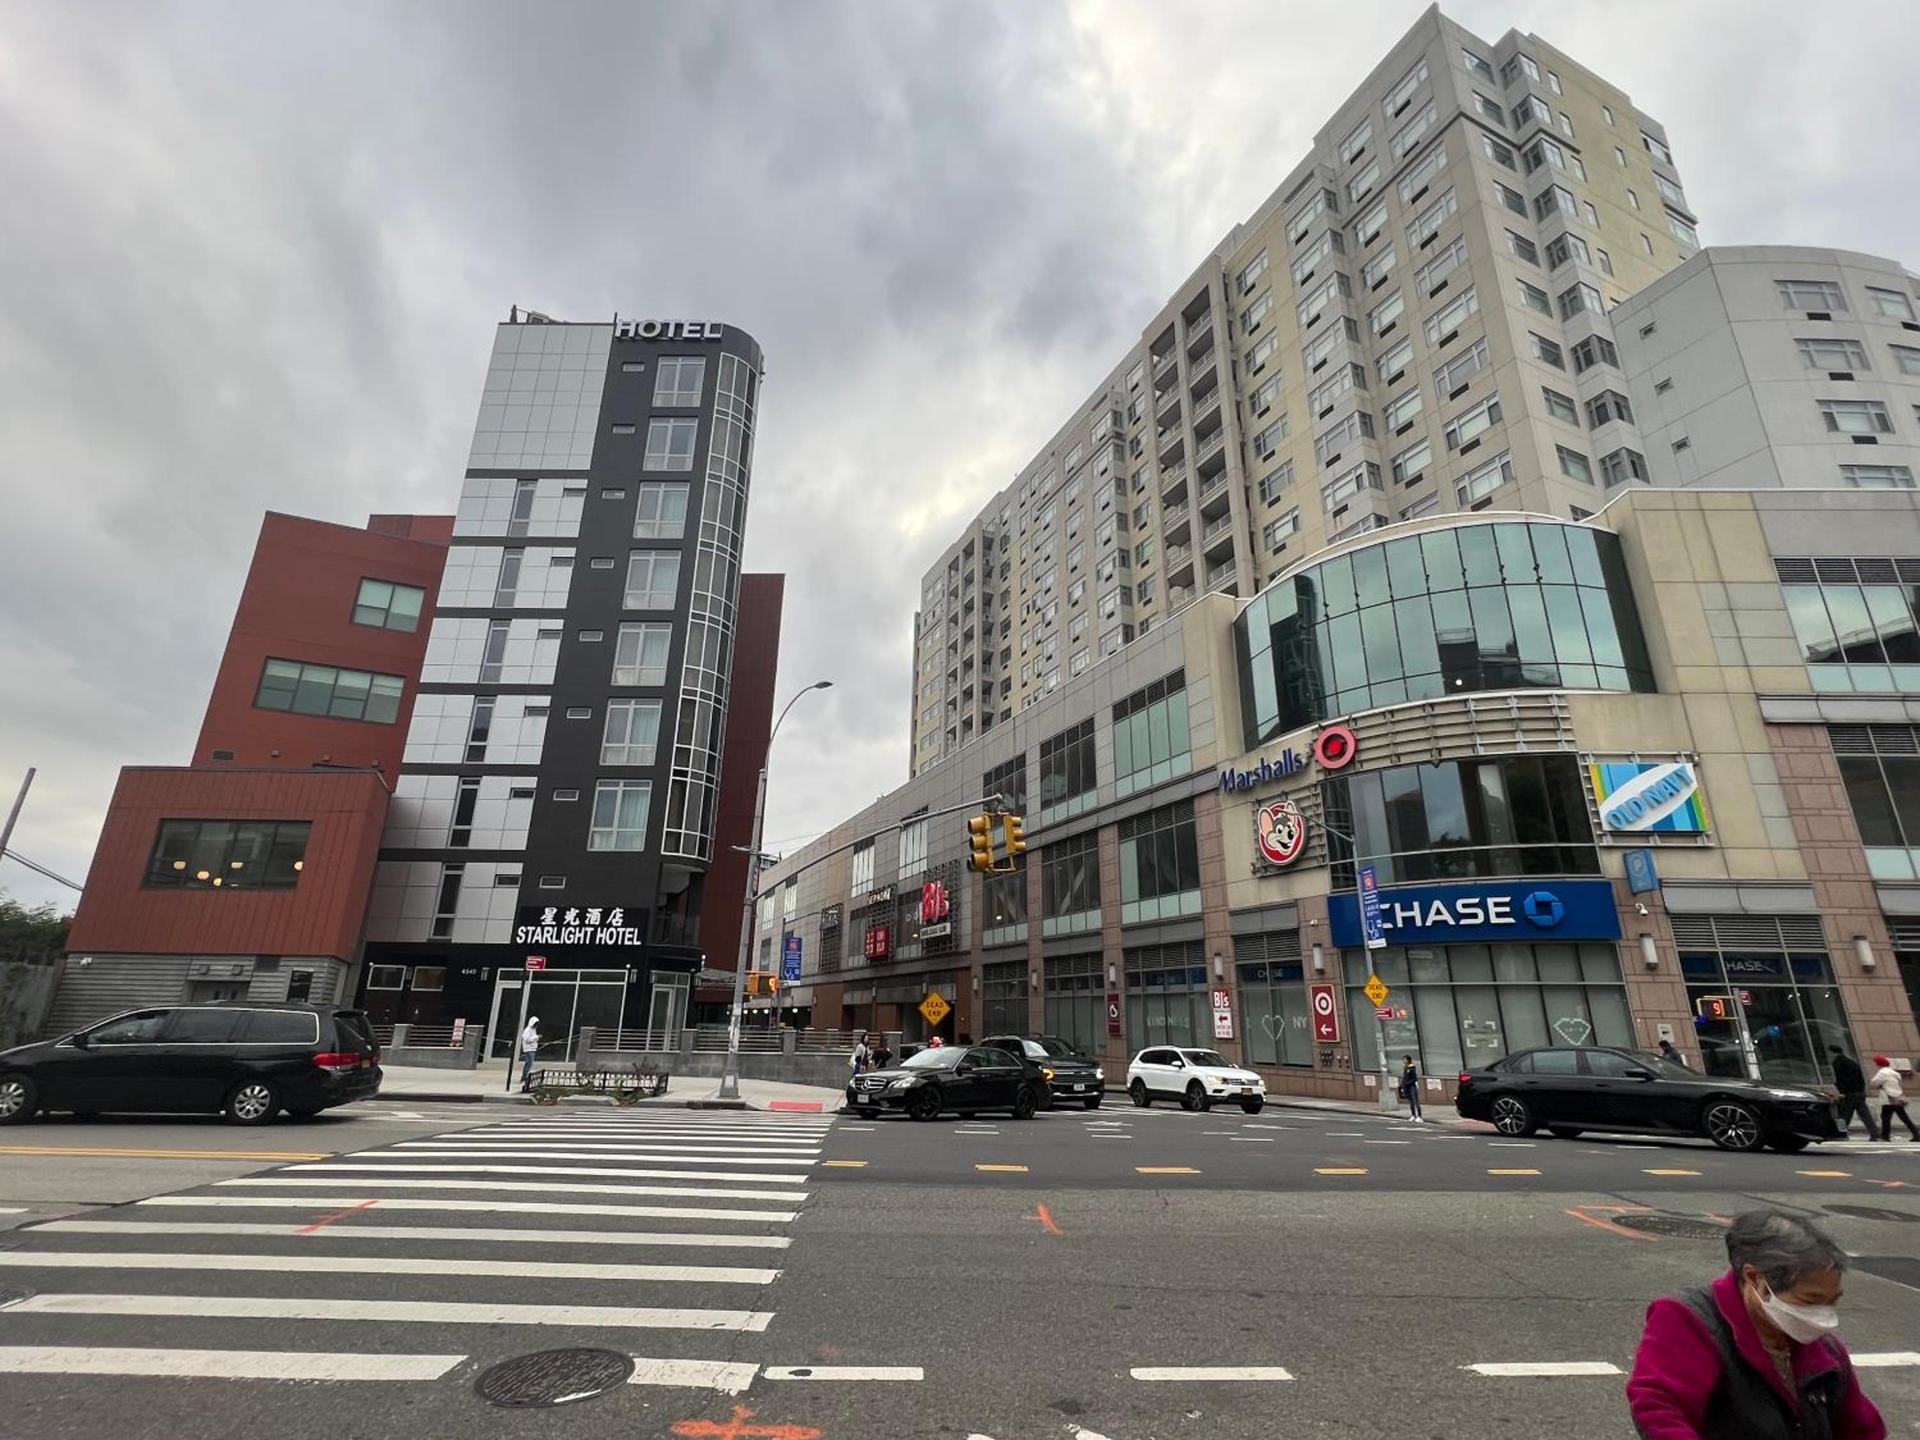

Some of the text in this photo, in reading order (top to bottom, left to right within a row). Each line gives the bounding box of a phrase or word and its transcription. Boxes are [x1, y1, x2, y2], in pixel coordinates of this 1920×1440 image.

[615, 319, 722, 338] HOTEL
[1219, 747, 1303, 793] Marshalls
[540, 906, 625, 926] 星光酒店
[516, 926, 642, 945] STARLIGHT HOTEL
[1213, 990, 1229, 1008] BJ's
[1713, 1003, 1720, 1014] 9
